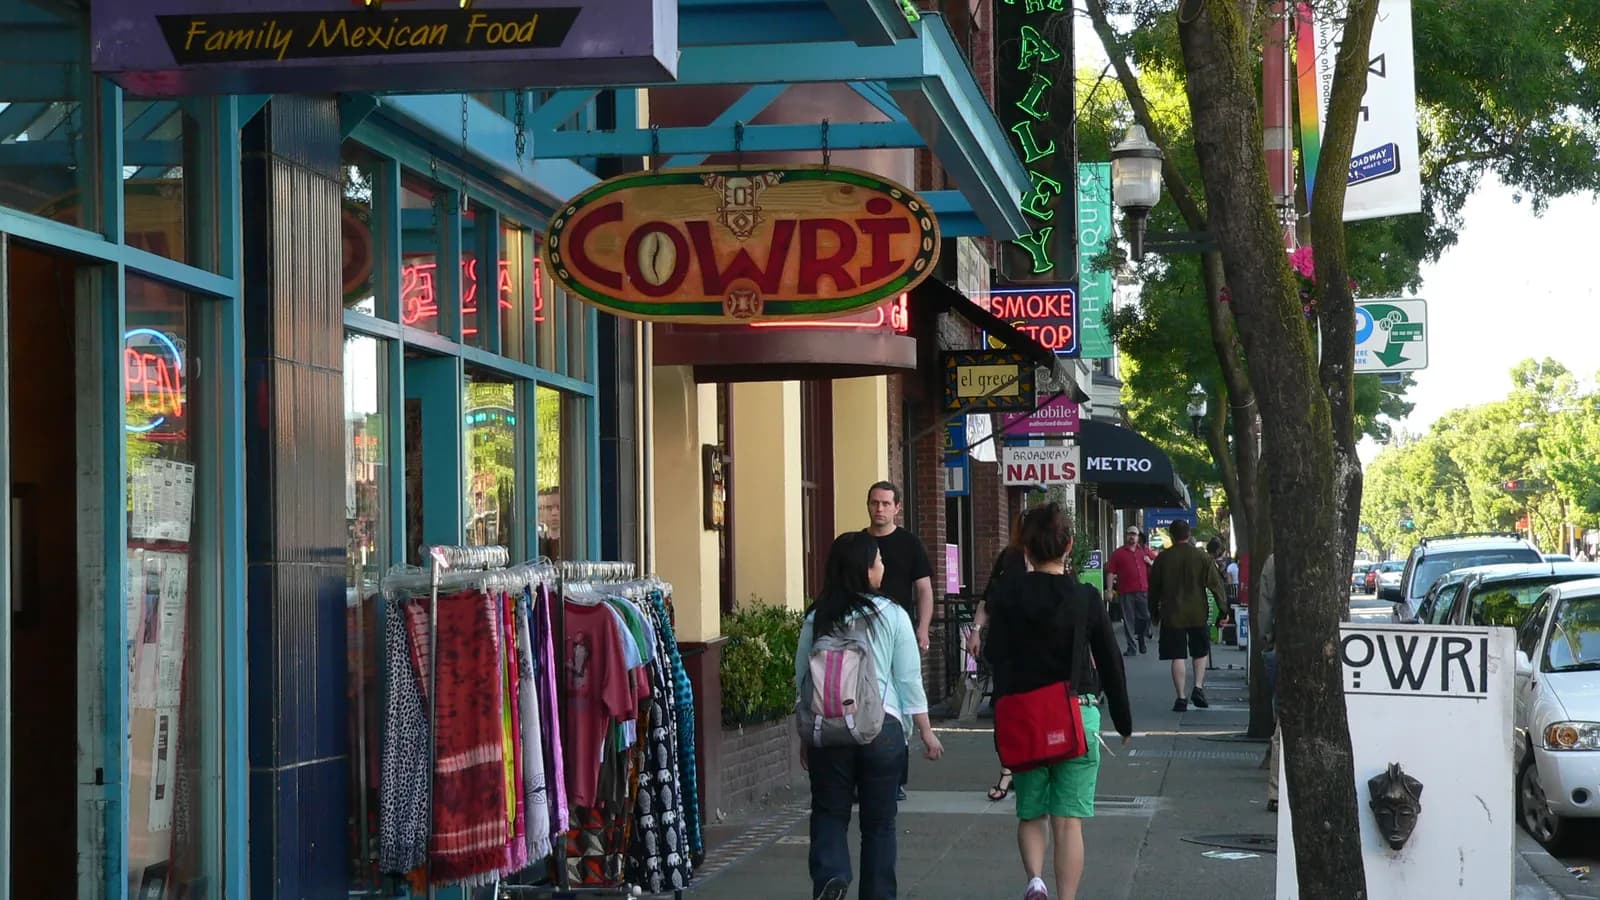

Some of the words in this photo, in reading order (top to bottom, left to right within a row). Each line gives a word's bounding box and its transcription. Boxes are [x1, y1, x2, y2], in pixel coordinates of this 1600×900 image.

[185, 20, 293, 62] Family
[307, 18, 449, 49] Mexican
[466, 14, 538, 44] Food
[1319, 19, 1328, 55] Always
[1321, 57, 1329, 70] on
[1011, 25, 1061, 272] ALLEY
[1350, 149, 1387, 169] OADWAY
[991, 295, 1071, 318] SMOKE
[1016, 325, 1072, 348] TOP
[125, 348, 182, 417] PEN
[960, 369, 972, 387] el
[978, 374, 1017, 394] greco
[1013, 451, 1069, 461] BROADWAY
[1086, 456, 1152, 472] METRO
[1007, 462, 1076, 482] NAILS
[1341, 634, 1488, 693] OWRI
